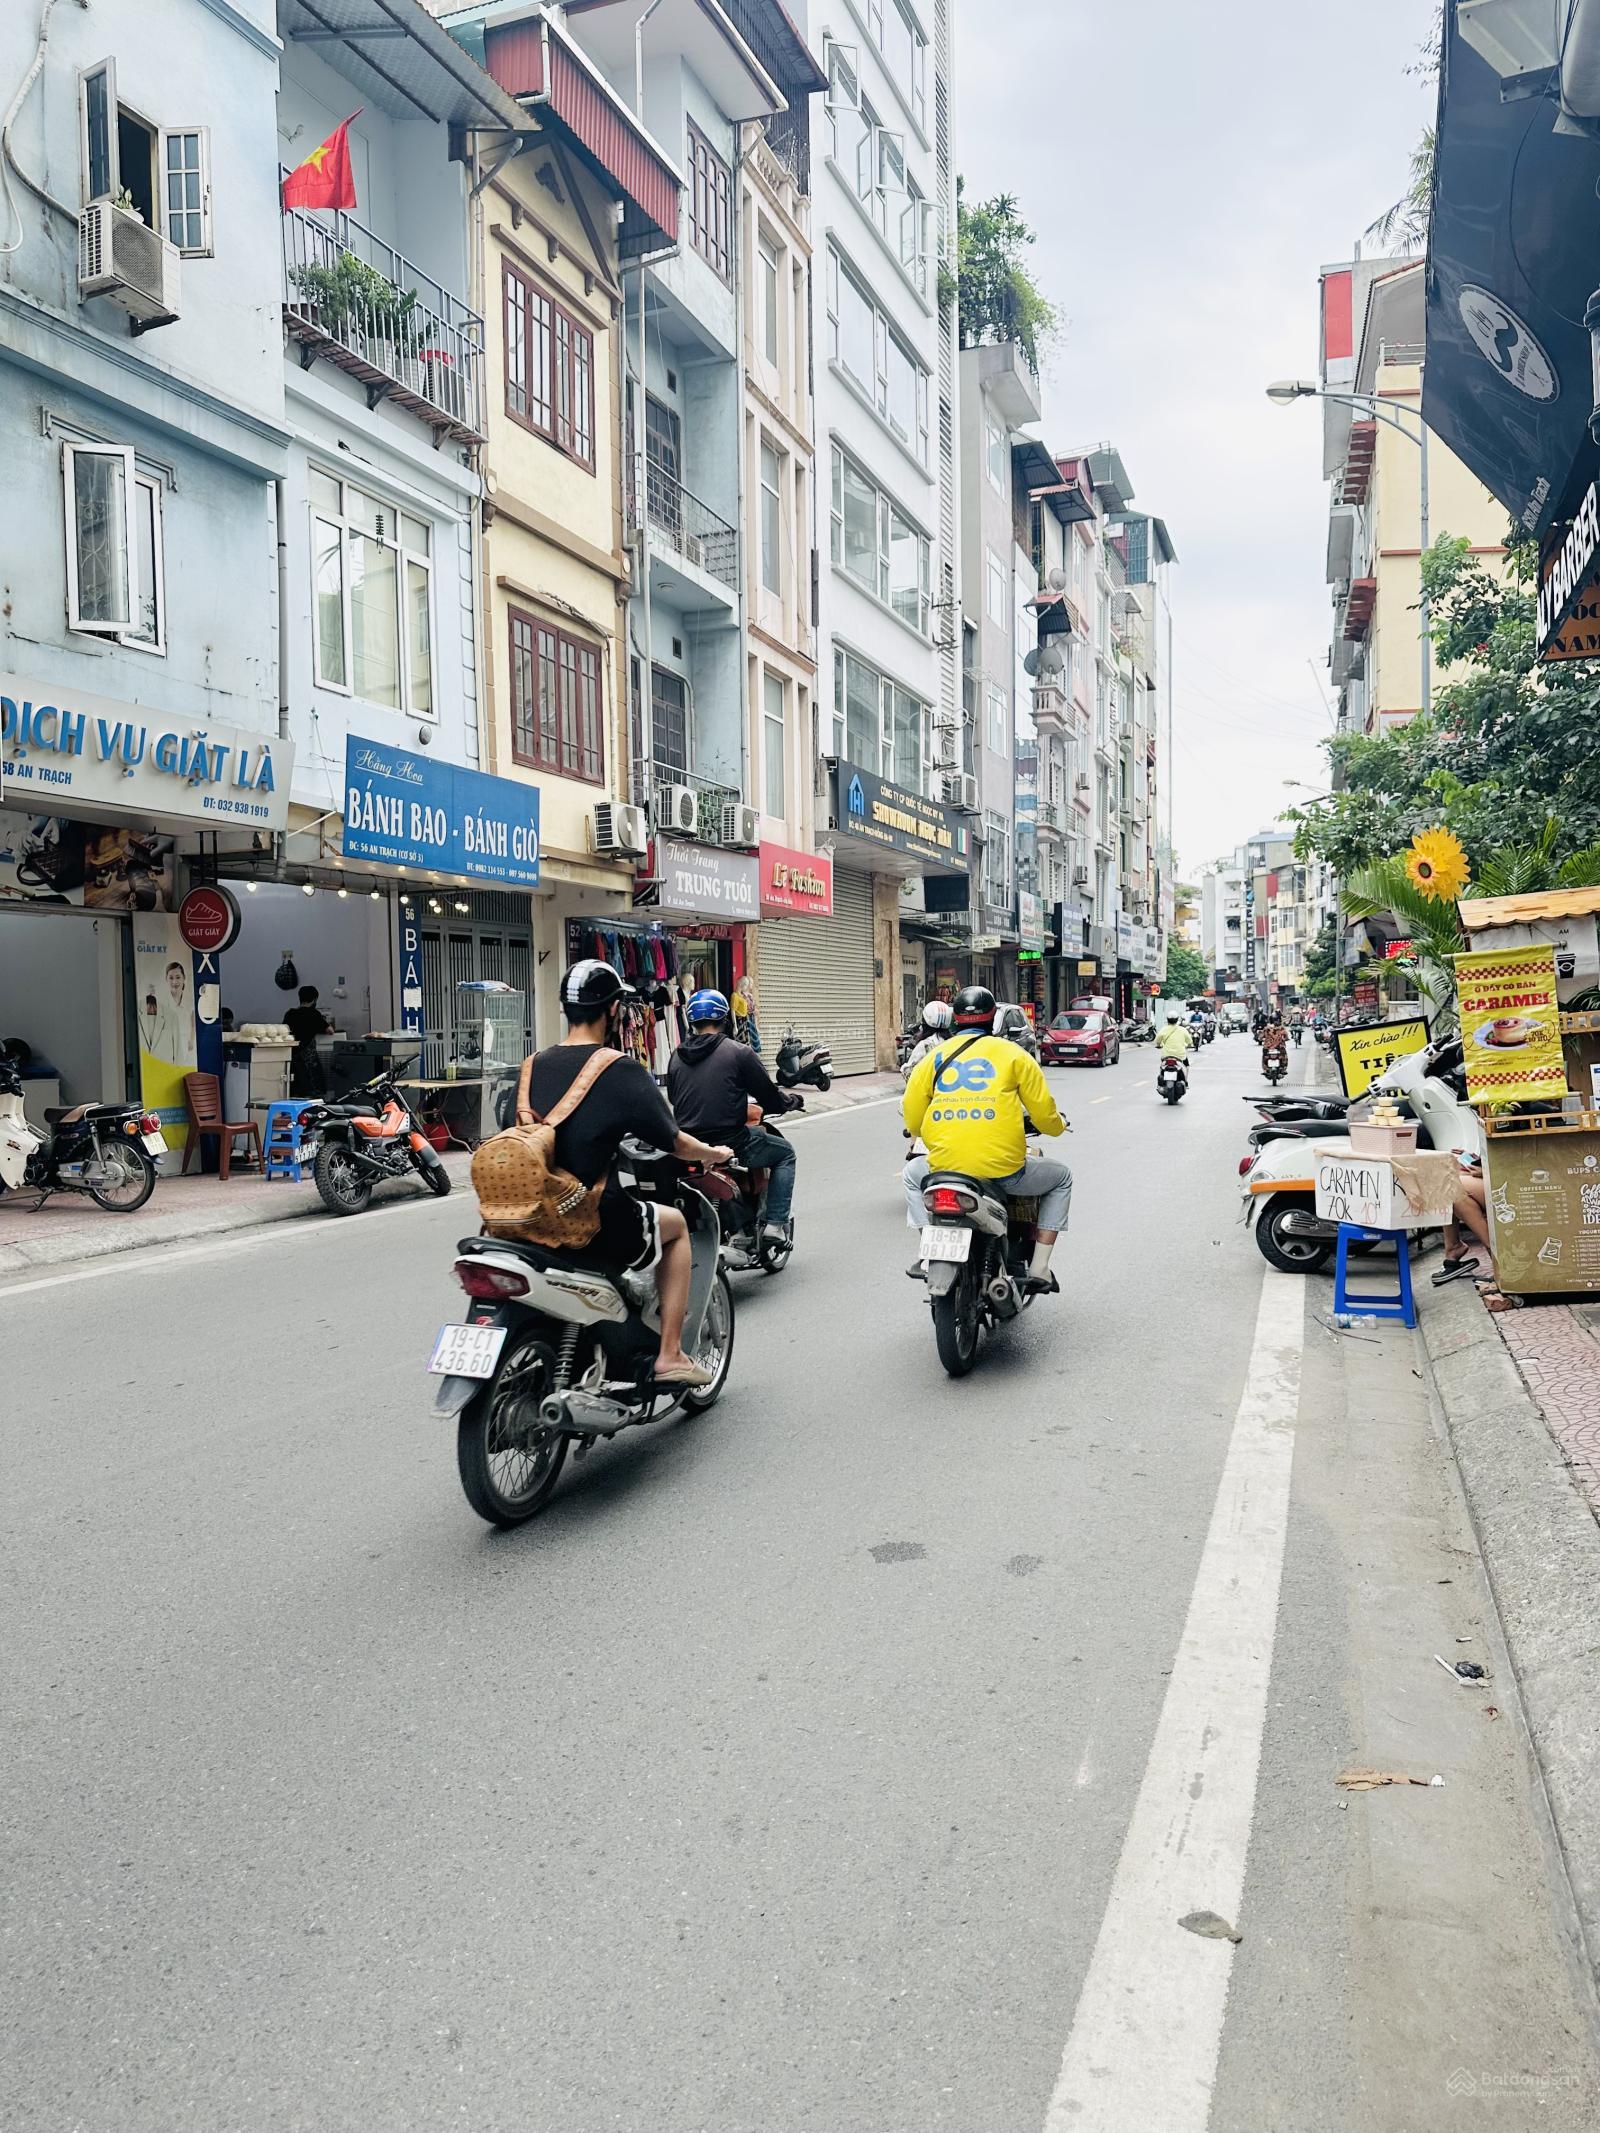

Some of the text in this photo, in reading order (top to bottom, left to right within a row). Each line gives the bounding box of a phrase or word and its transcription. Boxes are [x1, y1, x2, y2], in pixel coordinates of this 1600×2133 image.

[97, 718, 147, 777] VỤ
[154, 731, 230, 787] GIẶT
[237, 745, 275, 792] LÀ
[17, 764, 33, 778] AN
[38, 767, 72, 785] TRẠCH
[348, 778, 404, 838] BÁNH
[410, 802, 447, 846] BAO
[464, 806, 508, 858] BÁNH
[512, 817, 538, 863] GIÒ
[675, 870, 721, 898] TRUNG
[724, 873, 752, 903] TUỔI
[1350, 1040, 1371, 1052] Xin
[1320, 1165, 1380, 1199] CARAMEN
[450, 1328, 494, 1351] 19-C1
[435, 1350, 492, 1373] 436.60
